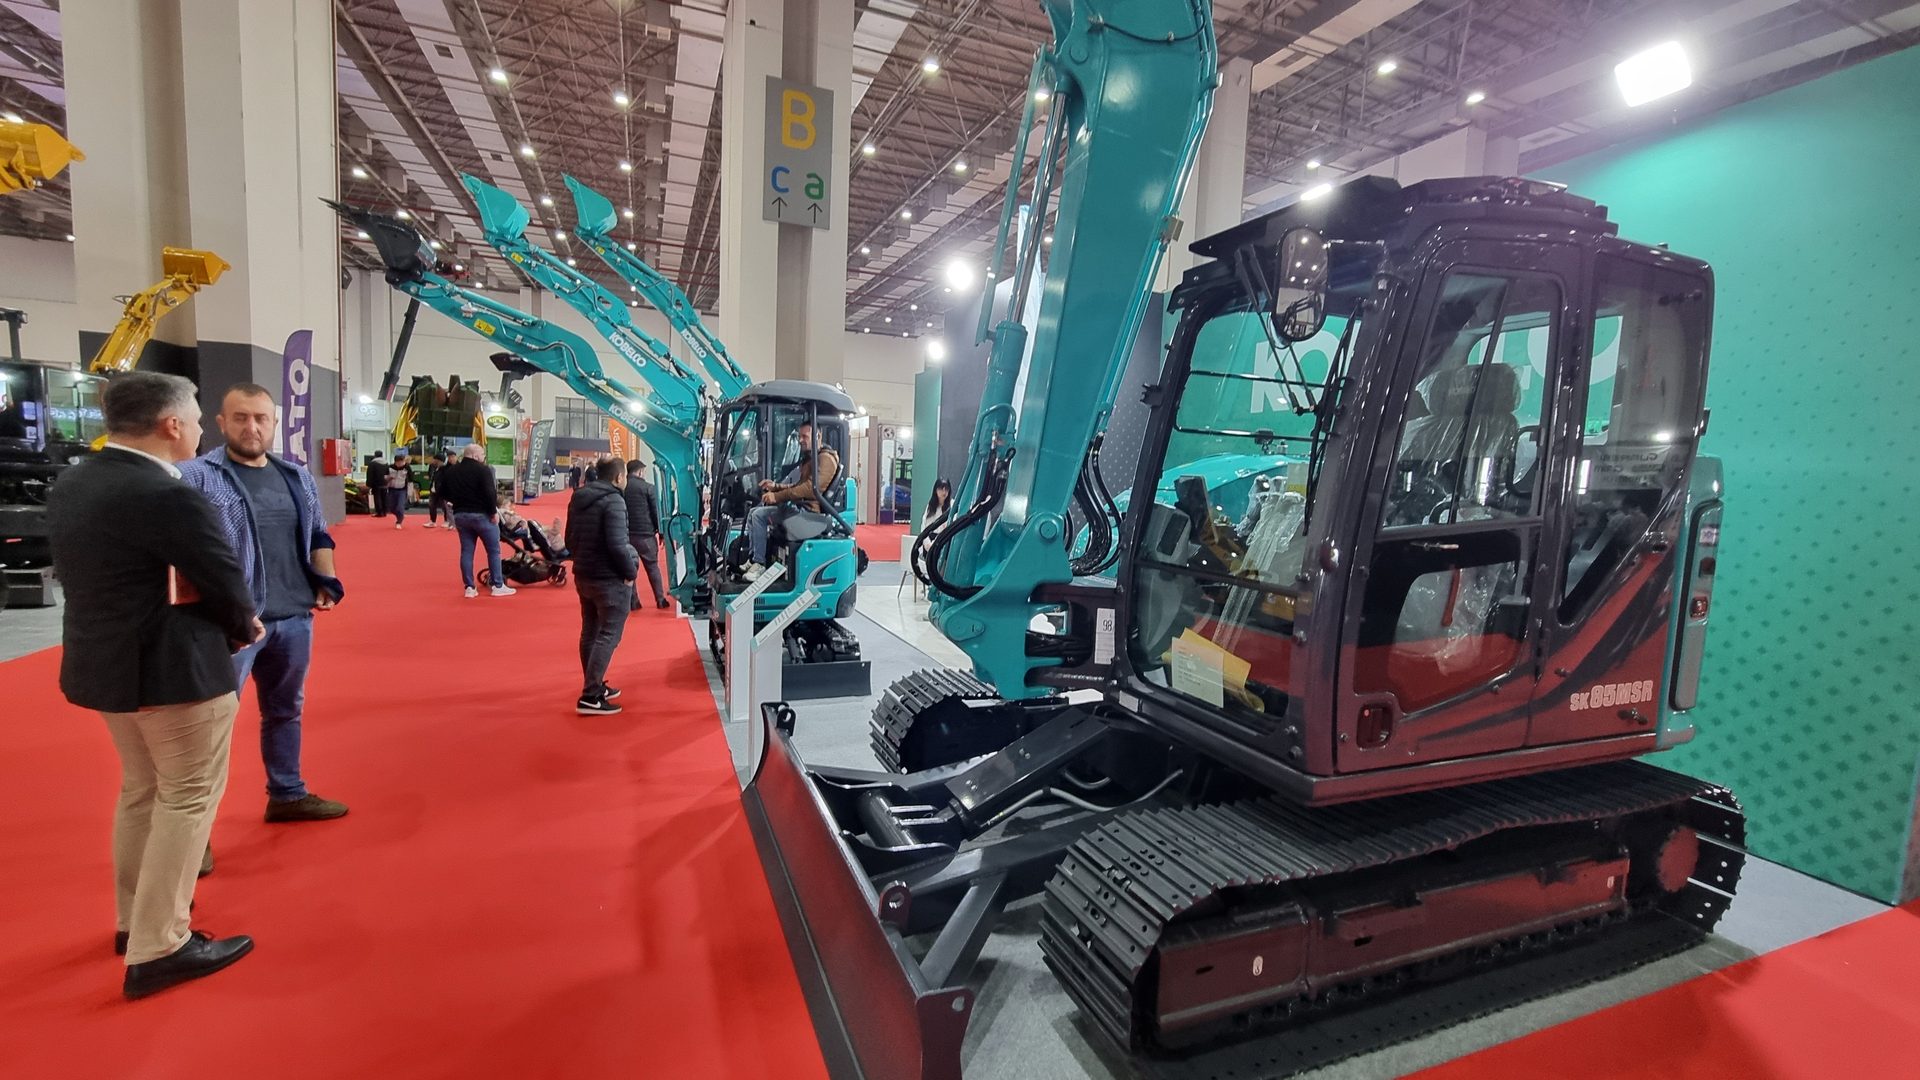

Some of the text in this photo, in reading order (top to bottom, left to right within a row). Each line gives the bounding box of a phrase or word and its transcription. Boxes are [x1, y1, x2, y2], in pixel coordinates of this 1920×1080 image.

[781, 88, 816, 150] B
[804, 172, 824, 200] a
[608, 331, 647, 367] KOBELCO
[681, 328, 707, 358] KOBELCO
[288, 358, 309, 469] ATO
[608, 403, 647, 433] KOBELCO
[1102, 619, 1112, 632] 98
[1569, 680, 1654, 711] SK85MSR
